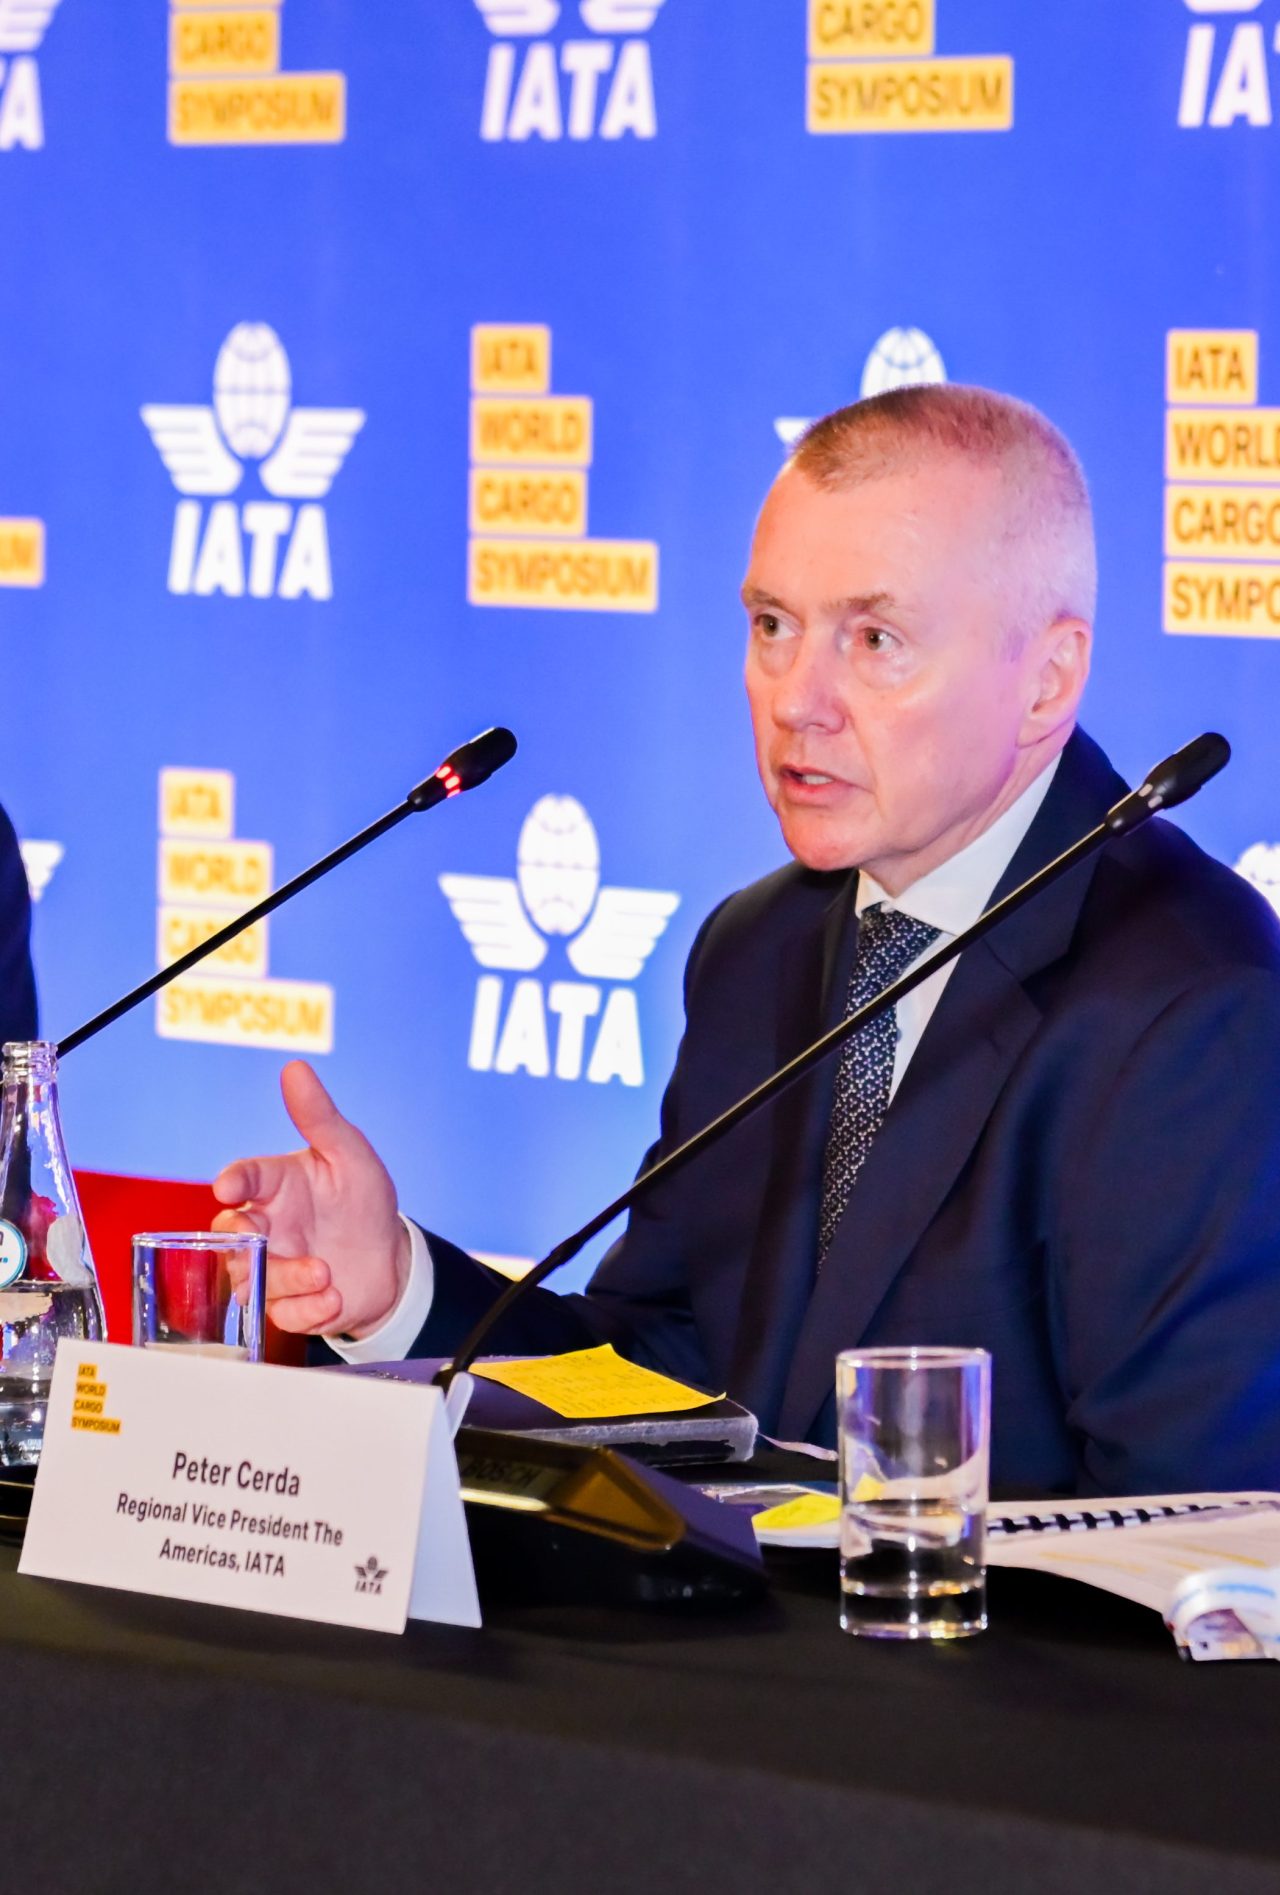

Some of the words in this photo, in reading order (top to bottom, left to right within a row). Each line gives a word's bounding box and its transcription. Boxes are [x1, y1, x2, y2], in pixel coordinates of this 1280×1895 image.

[481, 42, 656, 140] IATA
[814, 74, 1004, 119] SYMPOSIUM
[1176, 346, 1246, 391] IATA
[478, 479, 577, 524] CARGO
[168, 500, 332, 600] IATA
[476, 551, 650, 596] SYMPOSIUM
[468, 975, 644, 1087] IATA
[74, 1400, 103, 1414] CARGO
[76, 1382, 106, 1397] WORLD
[72, 1416, 120, 1433] SYMPOSIUM
[172, 1451, 231, 1488] Peter
[237, 1460, 301, 1496] Cerda
[116, 1493, 188, 1523] Regional
[192, 1504, 226, 1529] Vice
[229, 1509, 309, 1542] President
[314, 1521, 344, 1547] The
[158, 1538, 241, 1573] Americas,
[244, 1551, 286, 1577] IATA
[354, 1580, 382, 1595] IATA
